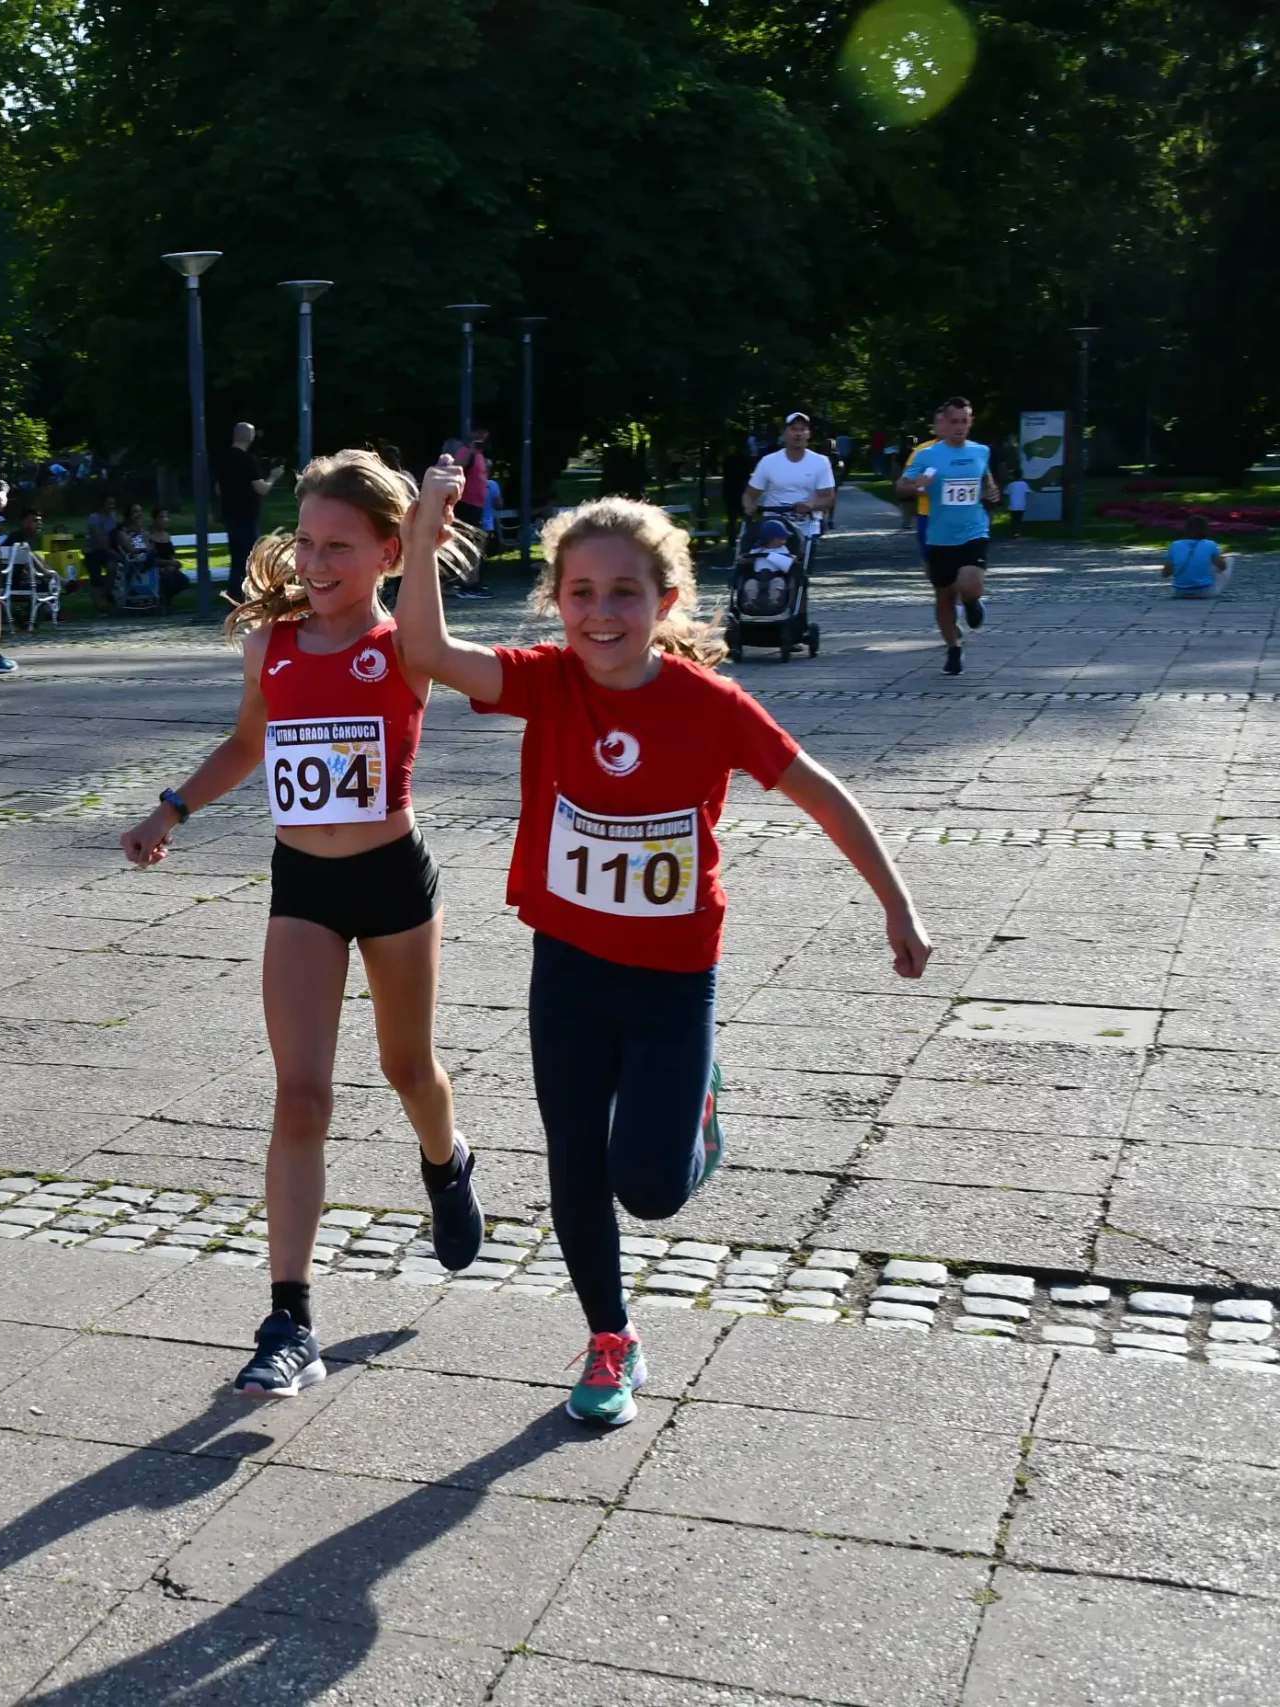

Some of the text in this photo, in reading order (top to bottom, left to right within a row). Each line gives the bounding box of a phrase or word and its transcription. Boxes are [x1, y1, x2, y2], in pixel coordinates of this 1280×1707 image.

[945, 488, 976, 502] 181
[299, 726, 330, 741] GRADA
[332, 724, 376, 740] ČAKOVCA
[274, 754, 375, 812] 694
[566, 845, 680, 905] 110
